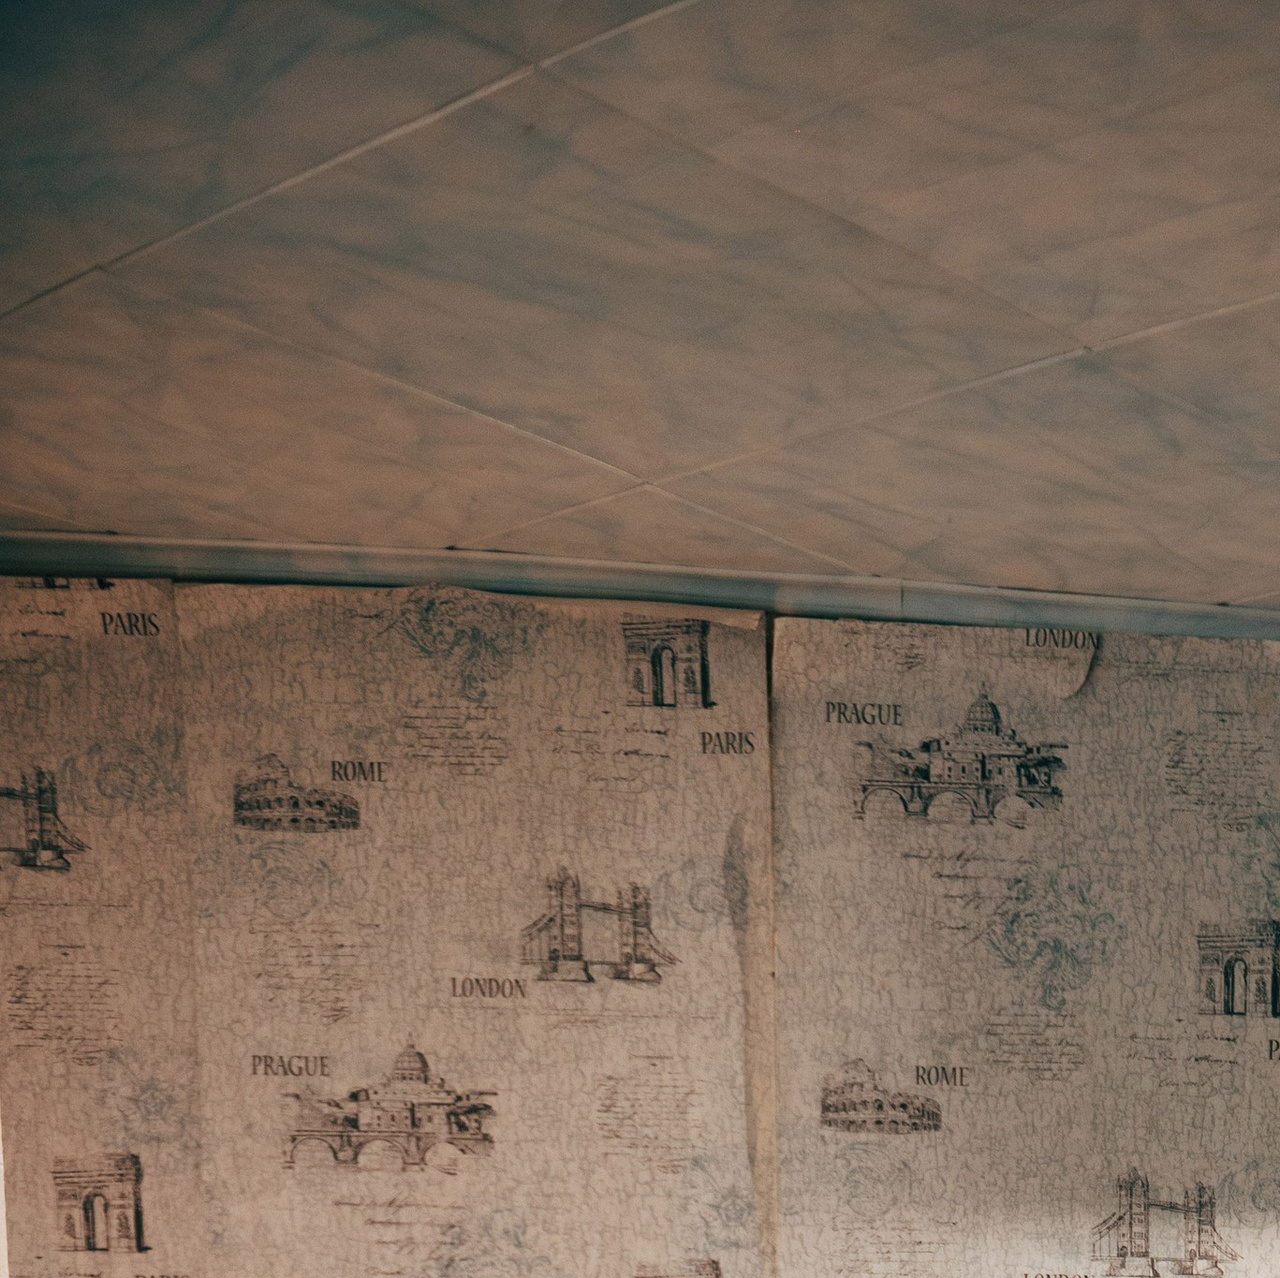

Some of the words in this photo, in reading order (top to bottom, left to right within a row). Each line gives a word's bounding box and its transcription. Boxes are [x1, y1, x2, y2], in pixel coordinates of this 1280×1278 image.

[100, 611, 160, 637] PARIS
[1025, 628, 1101, 650] LONDON
[825, 701, 902, 726] PRAGUE
[701, 731, 755, 755] PARIS
[330, 760, 388, 784] ROME
[450, 977, 527, 998] LONDON
[251, 1055, 330, 1077] PRAGUE
[914, 1065, 969, 1088] ROME
